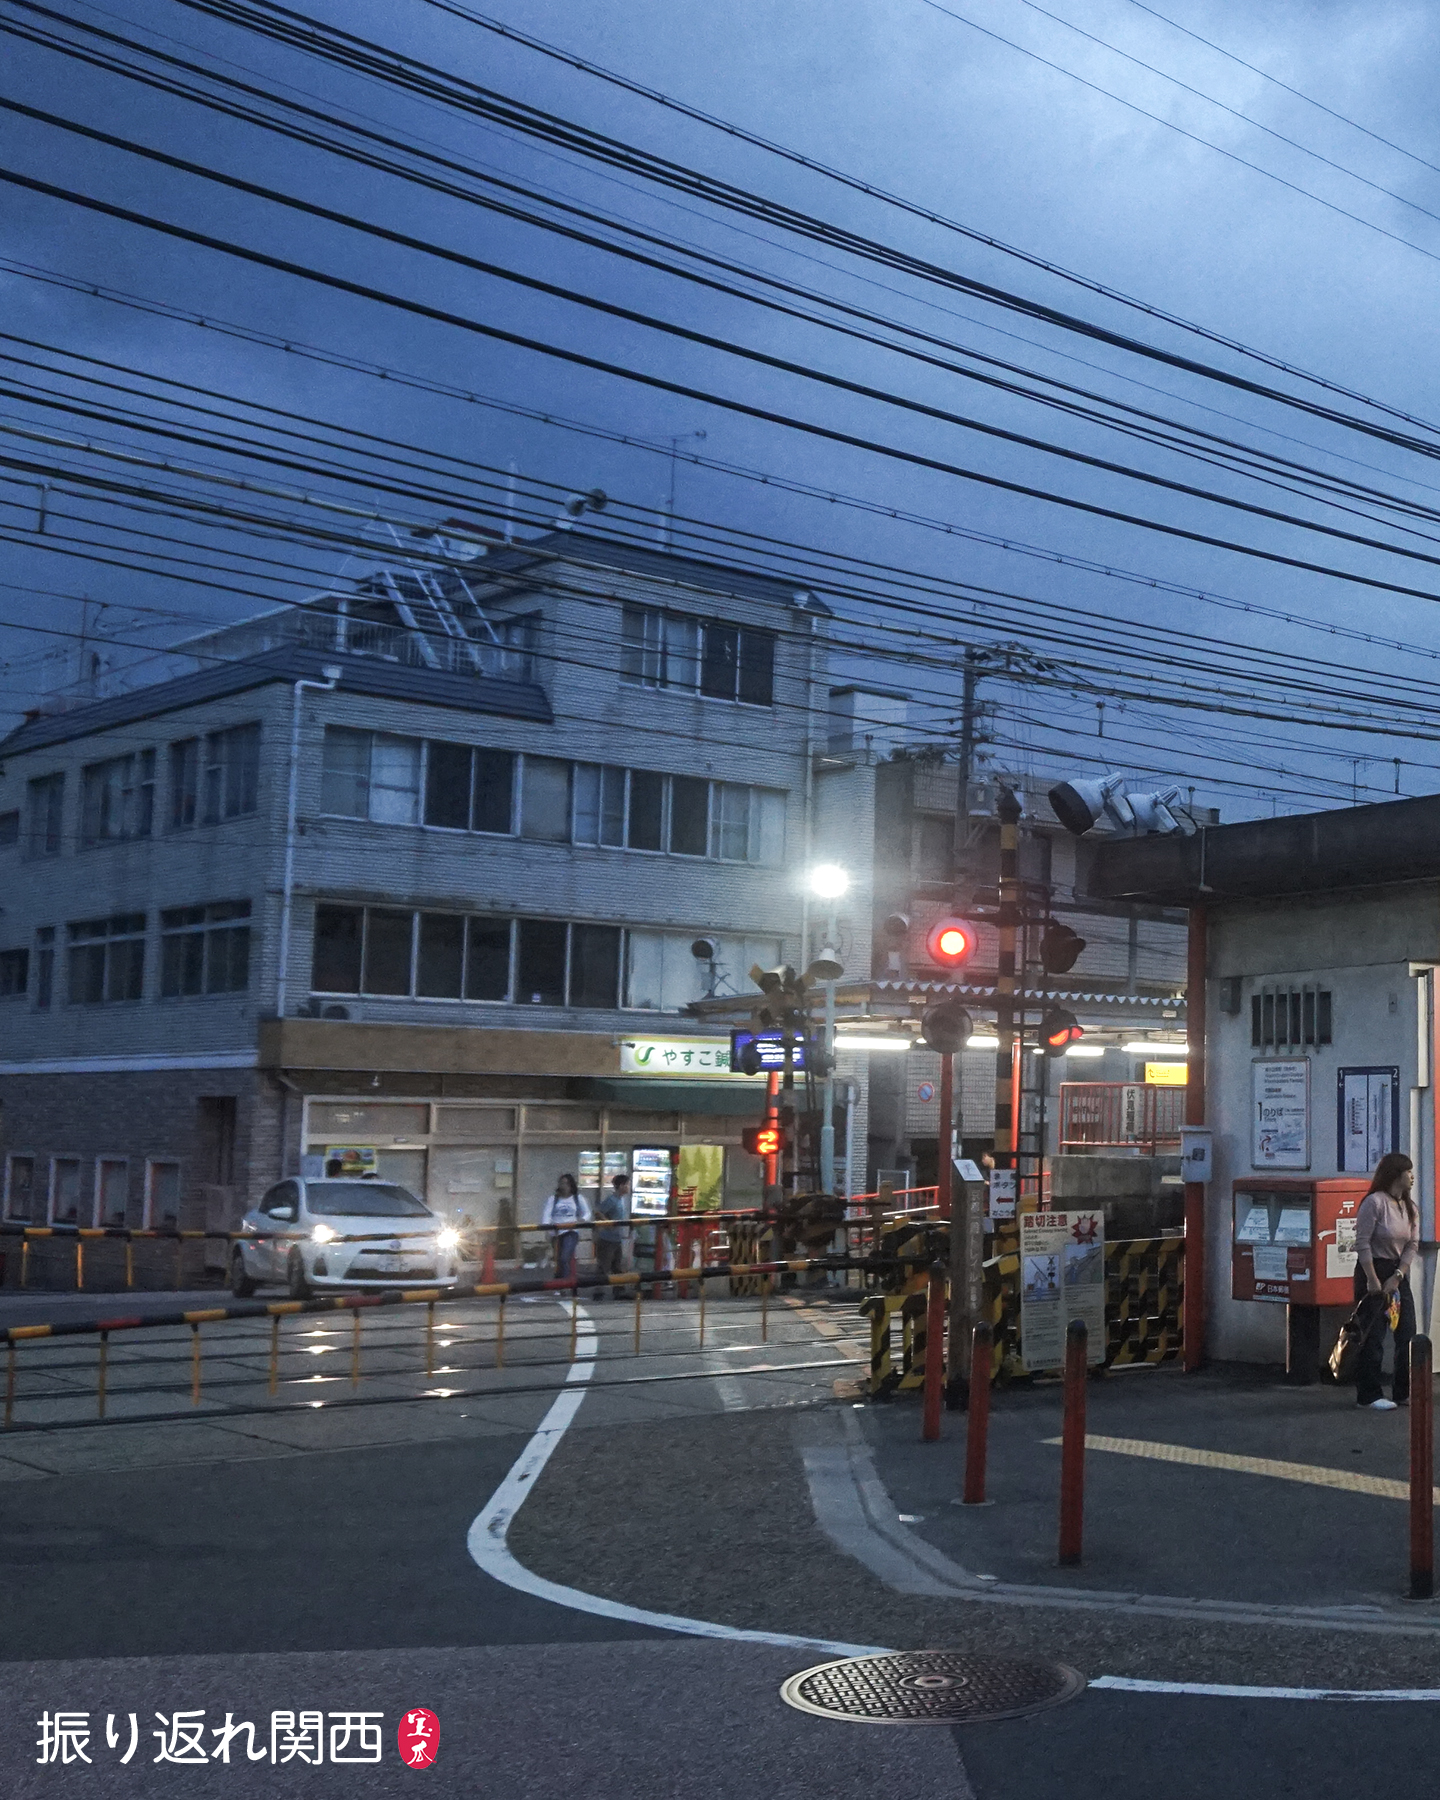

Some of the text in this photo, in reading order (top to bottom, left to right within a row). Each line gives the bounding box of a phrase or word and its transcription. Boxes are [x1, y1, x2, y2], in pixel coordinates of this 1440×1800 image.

[1339, 1069, 1343, 1080] 1
[1392, 1068, 1398, 1079] 2
[1023, 1214, 1068, 1229] 踏切注意
